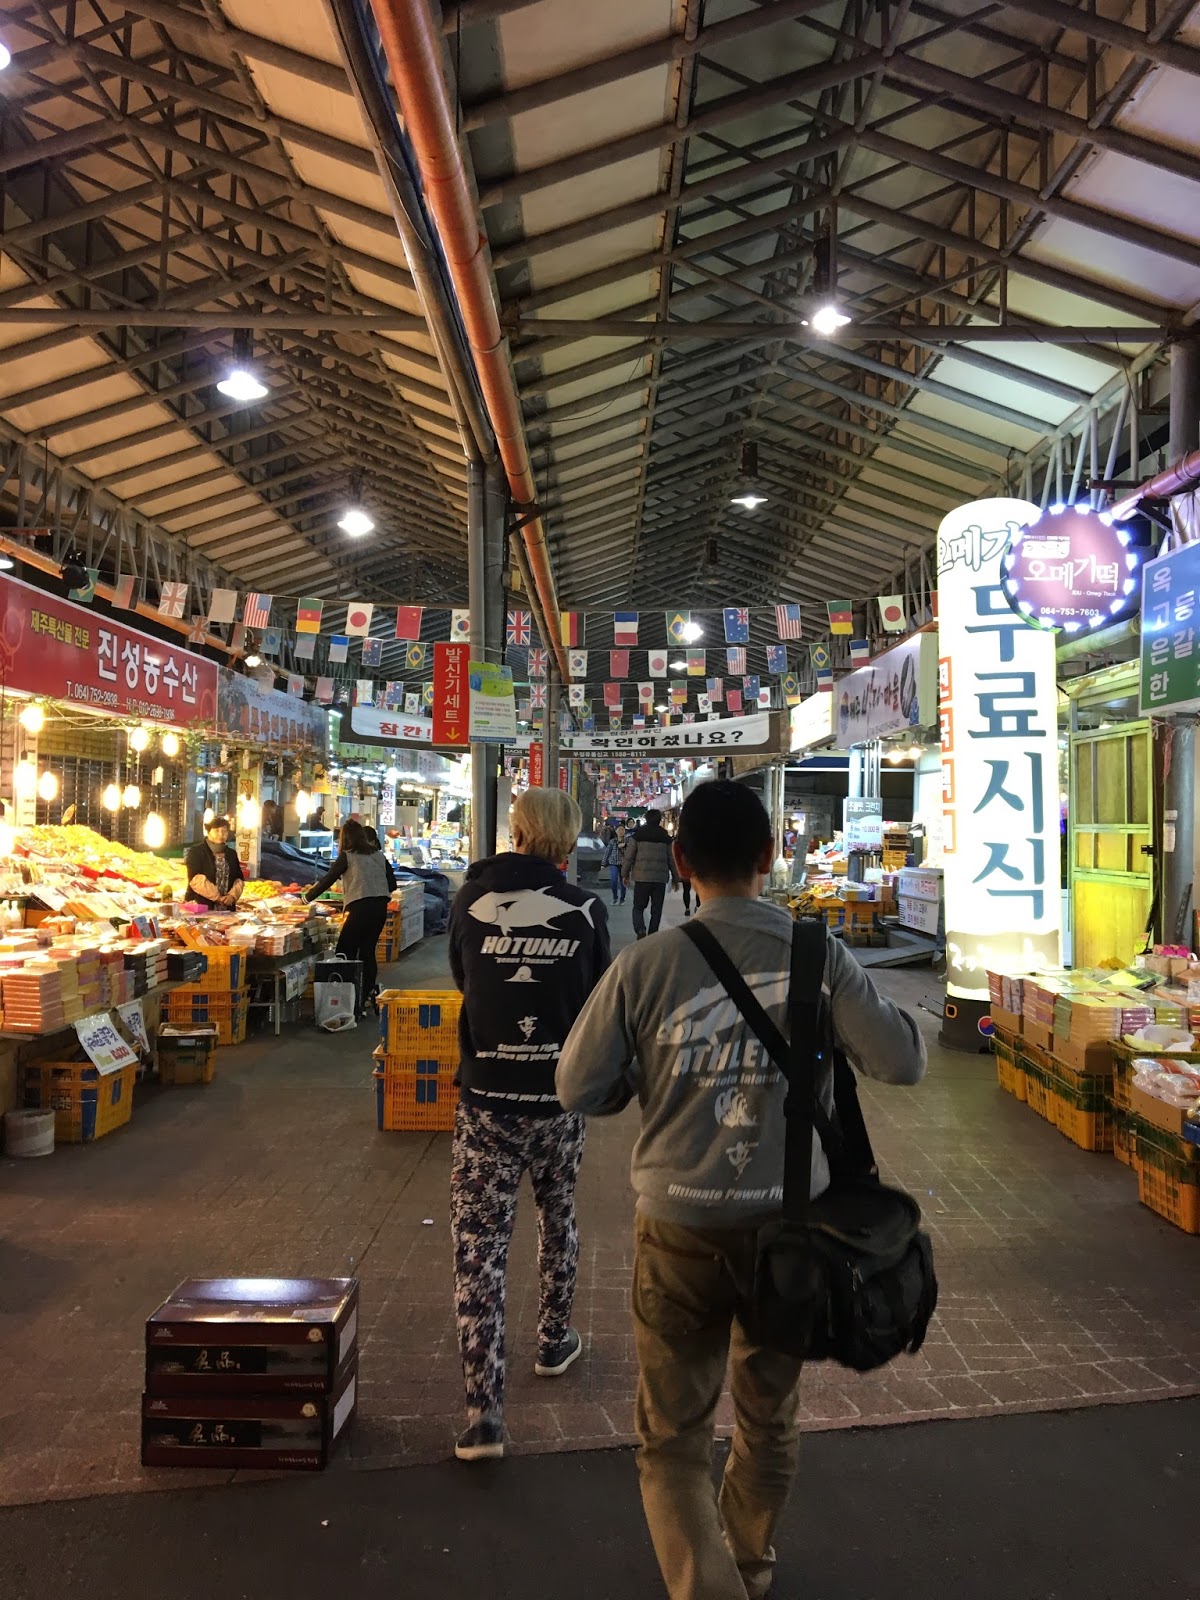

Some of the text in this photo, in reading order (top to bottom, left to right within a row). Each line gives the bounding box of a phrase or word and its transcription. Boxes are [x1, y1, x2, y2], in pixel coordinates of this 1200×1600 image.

[1023, 554, 1119, 592] 오메기떡
[1040, 607, 1100, 616] 064-753-7603
[31, 609, 90, 650] 제주특산물 전문
[98, 629, 198, 704] 진성농수산
[443, 648, 462, 723] 발신기세트
[379, 721, 432, 739] 잠깐!
[590, 730, 744, 748] 확인하셨나요?
[964, 584, 1048, 920] 무료시식
[480, 936, 580, 957] HOTUNA!
[668, 1184, 723, 1199] Ultimate
[725, 1188, 770, 1200] Power
